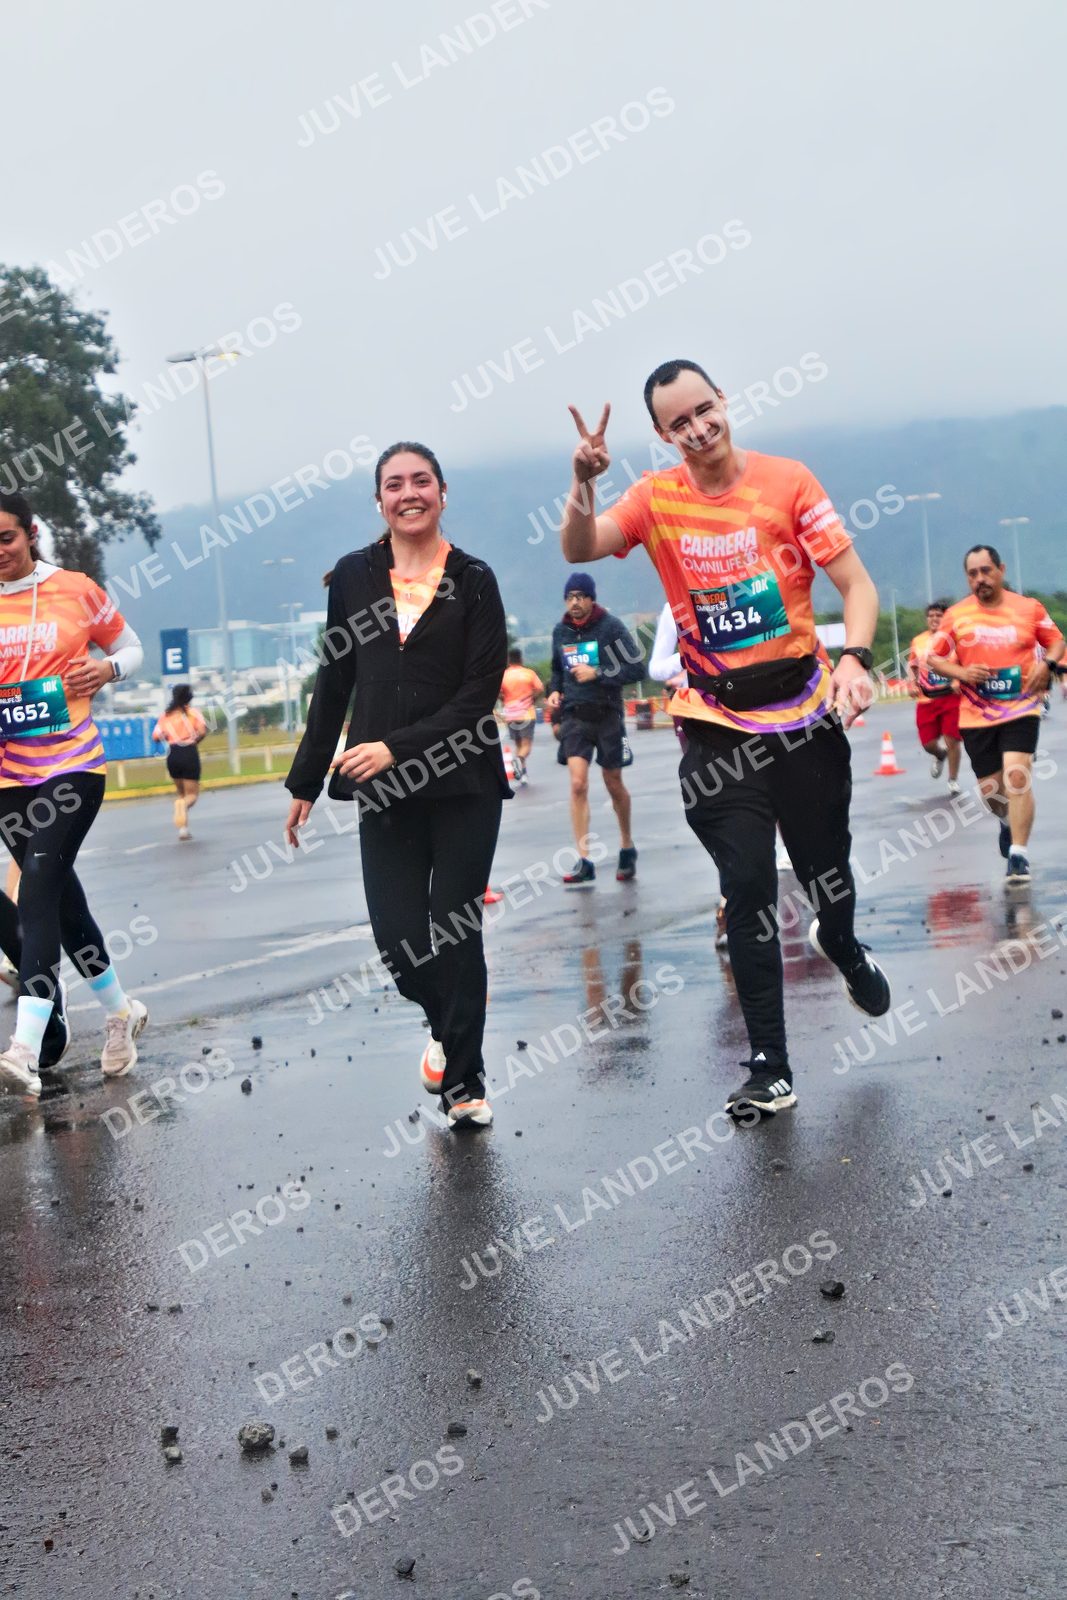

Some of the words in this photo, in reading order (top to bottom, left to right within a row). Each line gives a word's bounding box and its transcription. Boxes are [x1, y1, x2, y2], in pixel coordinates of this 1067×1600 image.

[680, 526, 757, 558] CARRERA
[682, 555, 743, 574] OMNILIFE
[751, 578, 769, 595] 10K
[706, 606, 762, 634] 1434
[166, 648, 183, 670] E
[42, 680, 58, 694] 10K
[2, 701, 51, 724] 1652
